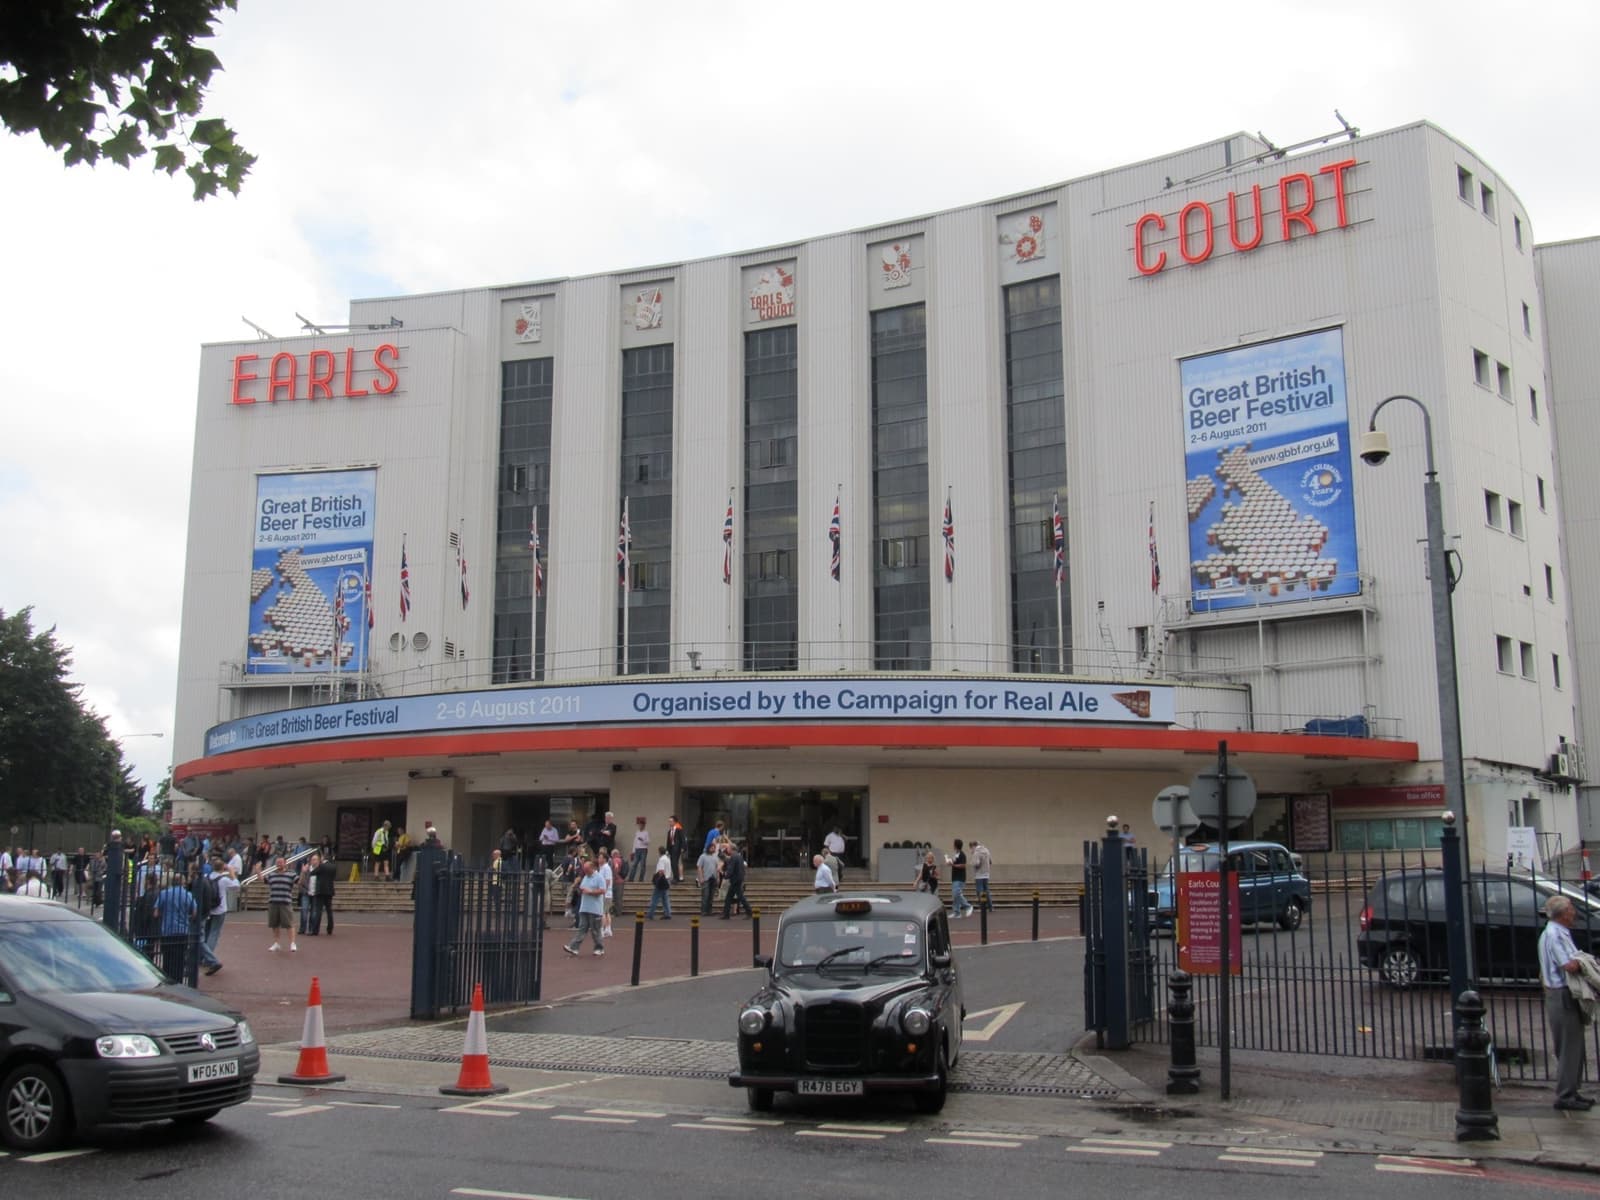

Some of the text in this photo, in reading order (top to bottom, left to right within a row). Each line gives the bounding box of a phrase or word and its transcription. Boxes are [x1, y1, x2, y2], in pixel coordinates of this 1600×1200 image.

[1134, 159, 1357, 275] COURT
[232, 344, 399, 405] EARLS
[1188, 380, 1249, 409] Great
[1255, 364, 1326, 396] British
[1190, 384, 1334, 430] Beer Festival
[1190, 421, 1267, 444] 2-6 August 2011
[1250, 438, 1335, 466] www.gbbf.org.uk
[261, 494, 362, 515] Great British
[260, 511, 366, 531] Beer Festival
[273, 533, 300, 542] August
[301, 532, 316, 541] 2011
[300, 551, 362, 566] www.gbbf.org.uk
[241, 725, 254, 742] The
[255, 722, 279, 737] Great
[281, 714, 312, 735] British
[314, 713, 342, 731] Beer
[345, 705, 399, 727] Festival
[436, 702, 466, 721] 2-6
[470, 697, 536, 721] August
[540, 695, 581, 715] 2011
[632, 690, 751, 717] Organised
[757, 690, 786, 714] by
[793, 690, 831, 710] the
[837, 689, 957, 714] Campaign
[964, 690, 998, 710] for
[1004, 690, 1053, 711] Real
[1059, 690, 1099, 712] Ale
[1188, 879, 1219, 888] Earls Cou
[192, 1061, 236, 1080] WF05 KND
[802, 1080, 858, 1092] R478 EGY
